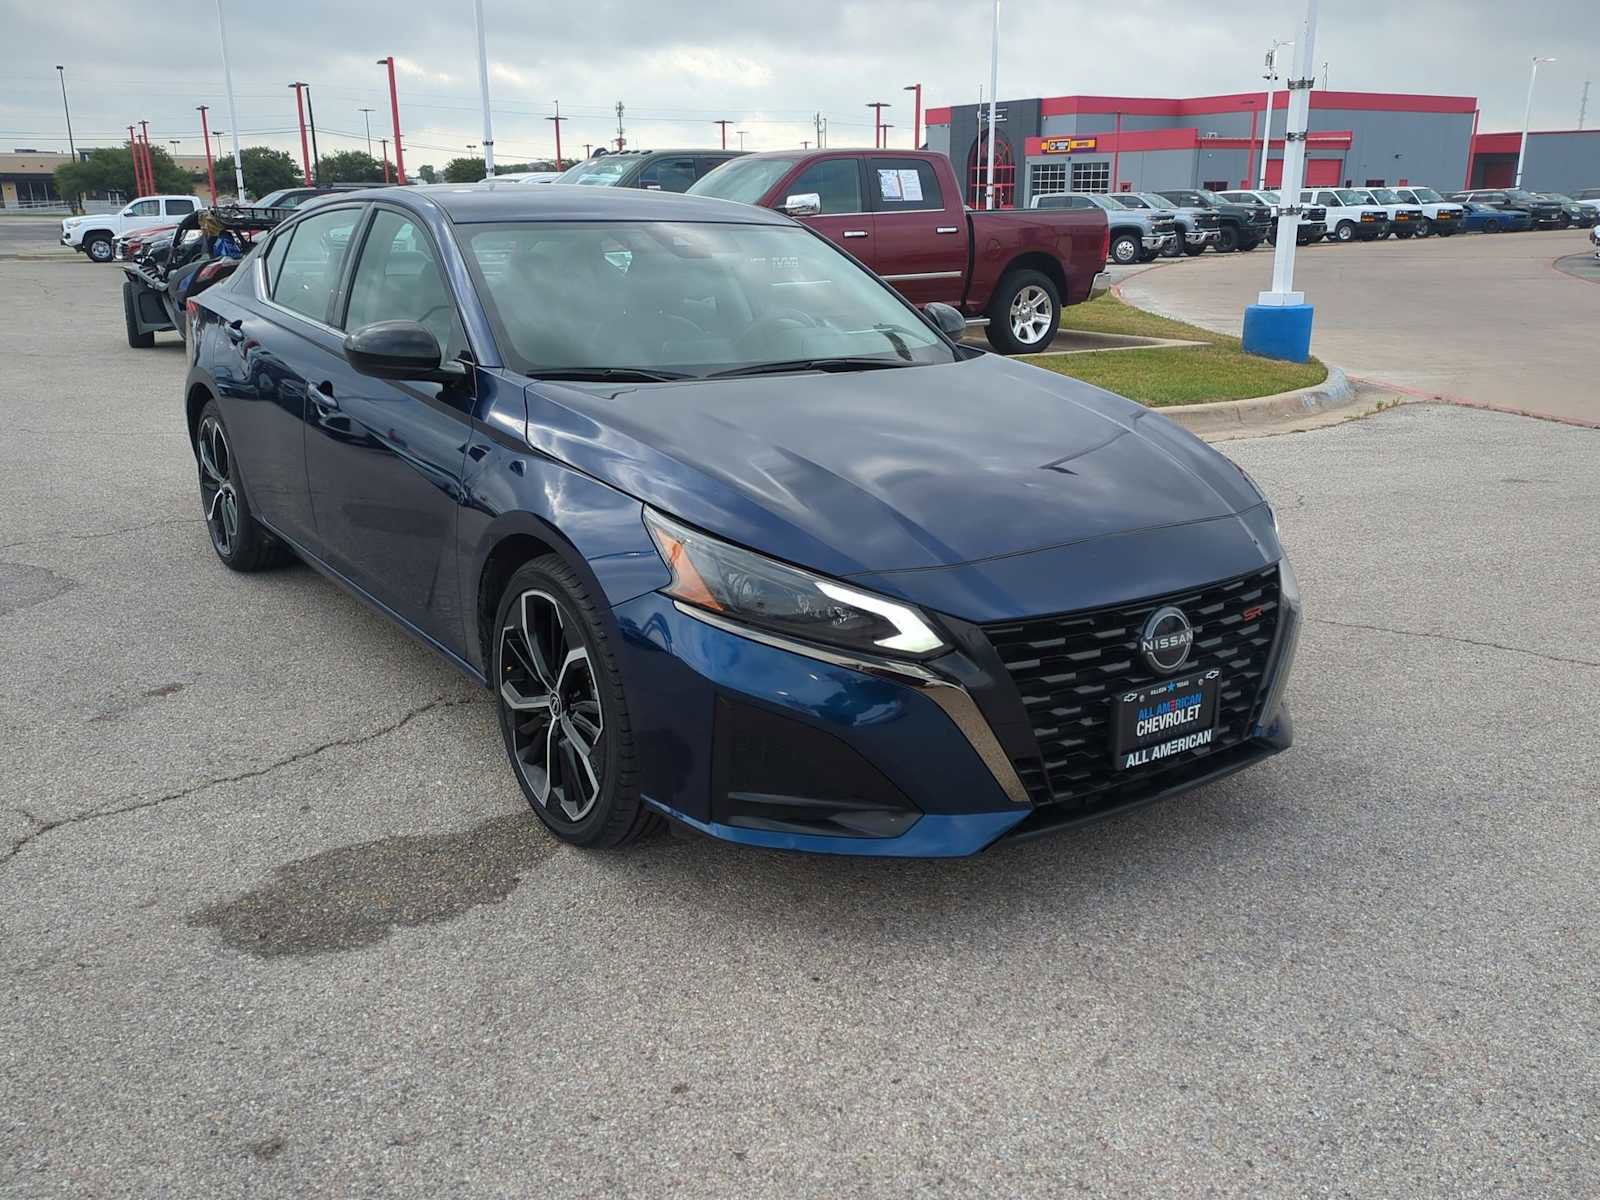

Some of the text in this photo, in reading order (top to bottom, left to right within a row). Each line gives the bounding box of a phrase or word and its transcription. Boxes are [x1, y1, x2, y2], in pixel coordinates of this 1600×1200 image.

[1243, 606, 1265, 621] SR
[1142, 630, 1194, 651] NISSAN
[1136, 704, 1201, 737] CHEVROLET
[1138, 692, 1202, 721] ALL AMERICAN
[1125, 749, 1150, 769] ALL
[1151, 729, 1212, 761] AMERICAN
